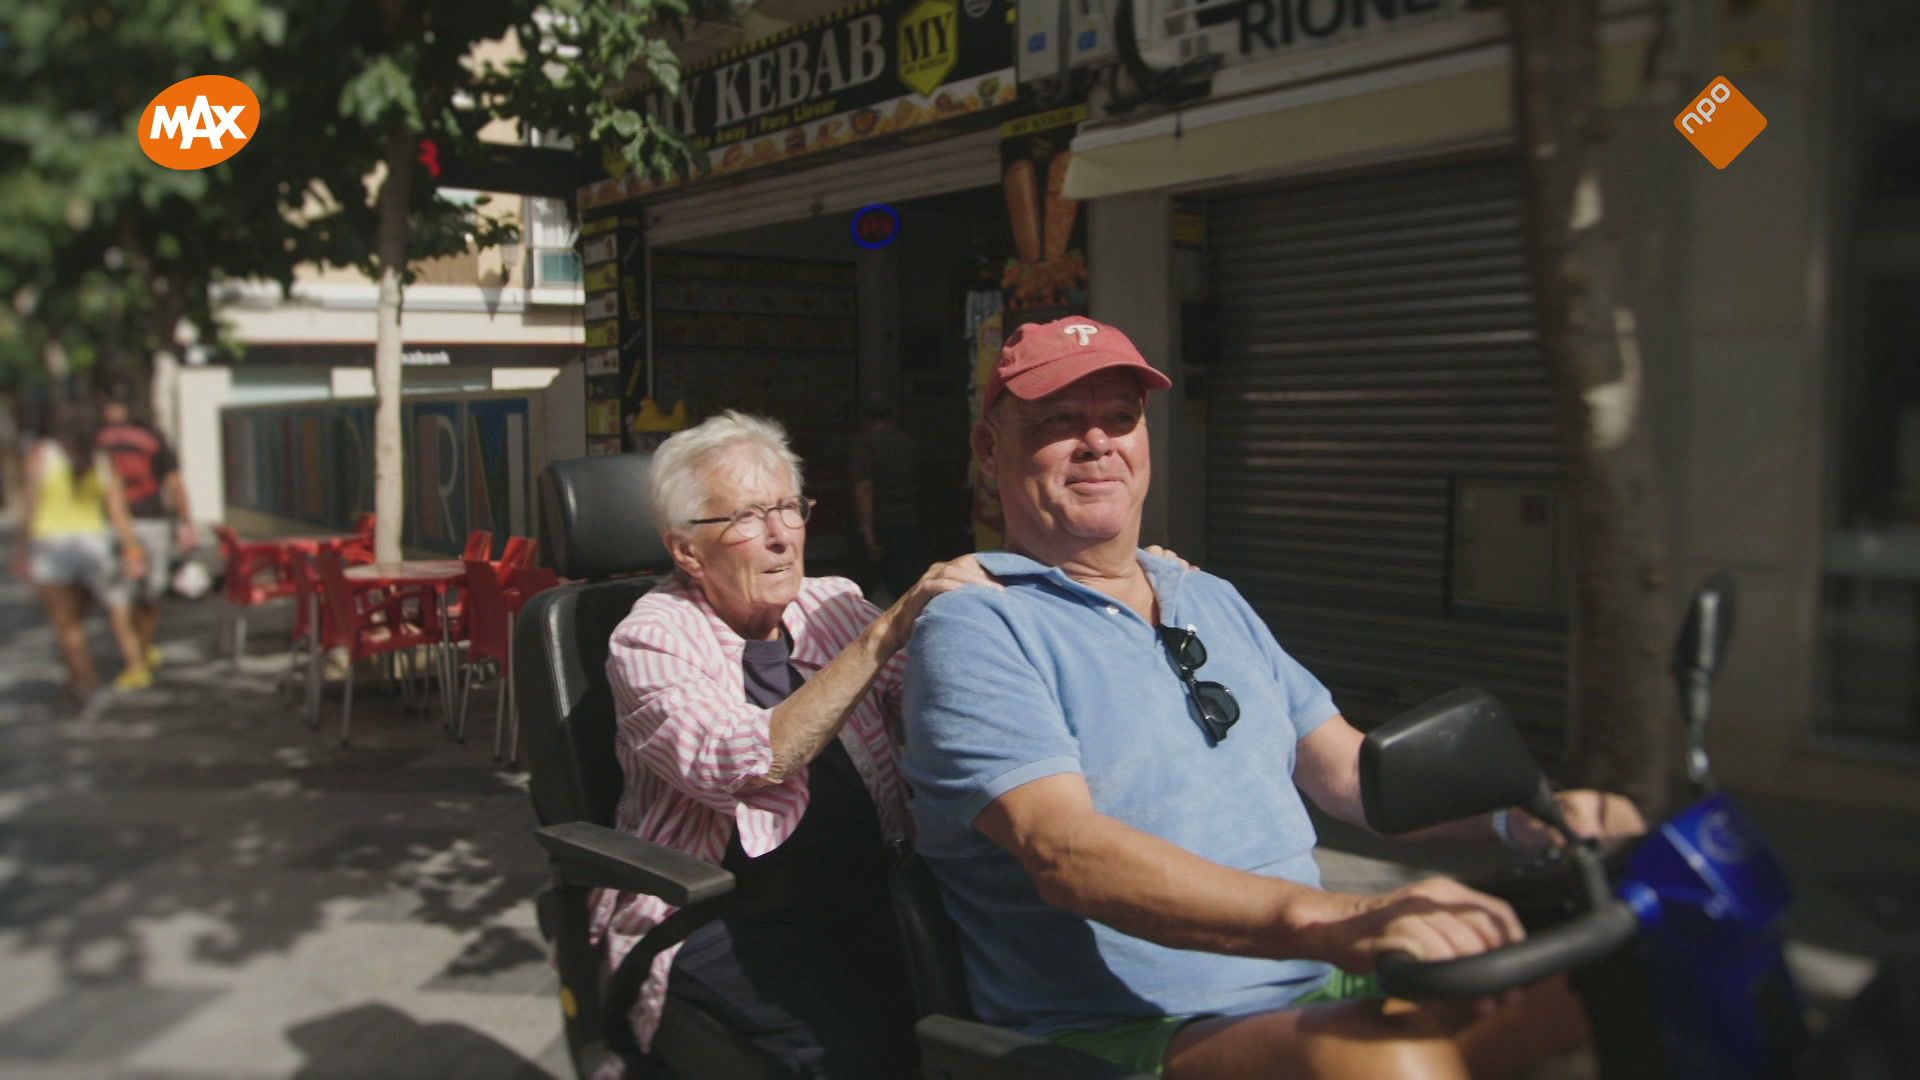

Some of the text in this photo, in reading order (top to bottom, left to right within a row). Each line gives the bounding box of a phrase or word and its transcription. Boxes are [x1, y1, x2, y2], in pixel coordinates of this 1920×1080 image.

[645, 14, 886, 135] MY KEBAB
[902, 13, 952, 63] MY
